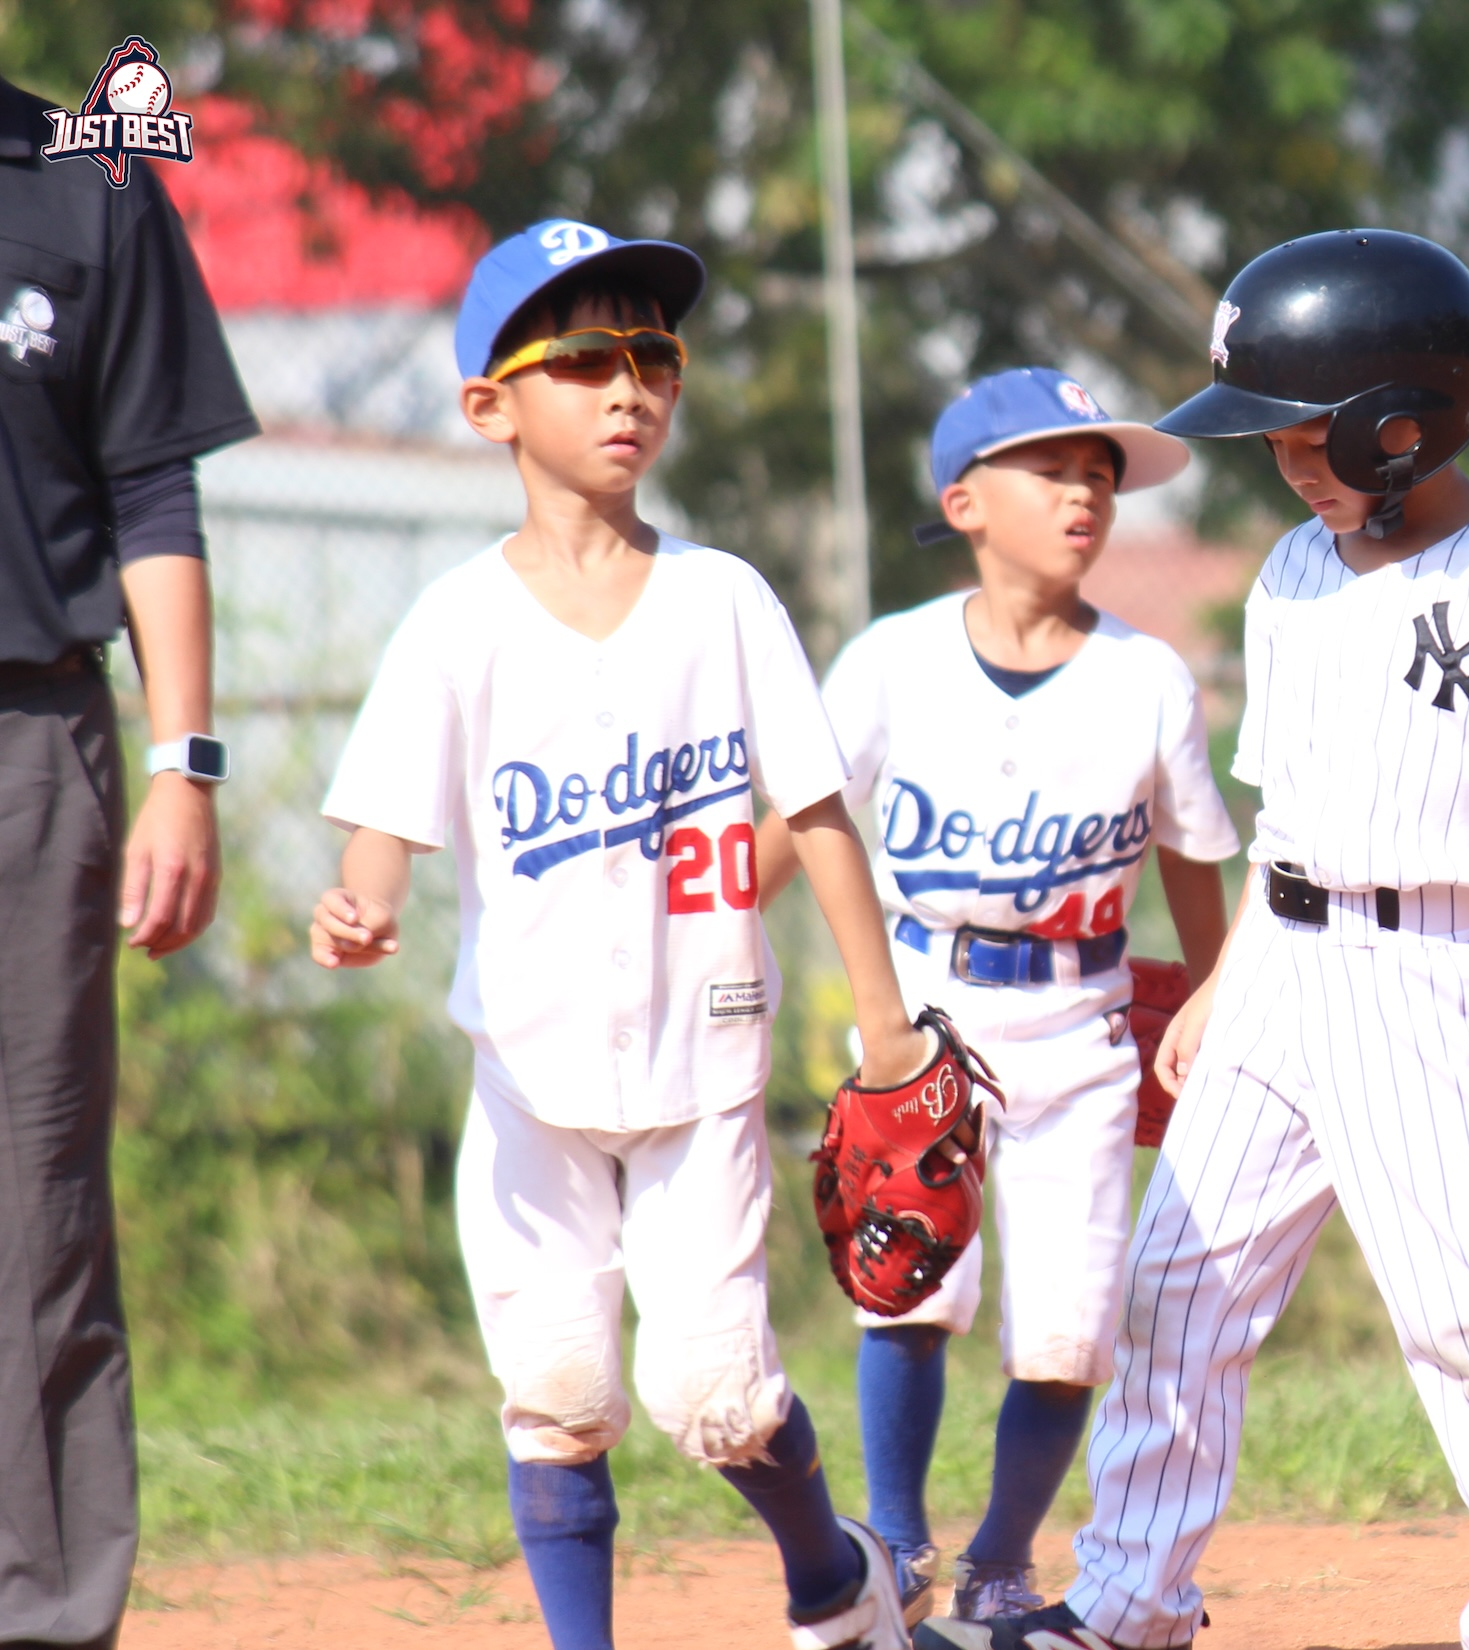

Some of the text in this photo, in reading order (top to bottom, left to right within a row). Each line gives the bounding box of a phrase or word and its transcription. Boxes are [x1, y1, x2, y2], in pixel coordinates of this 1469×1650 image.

[540, 222, 609, 266] D
[0, 321, 58, 357] UST BEST
[492, 727, 749, 862] Dodgers
[666, 822, 758, 915] 20
[881, 777, 1153, 913] Dodgers
